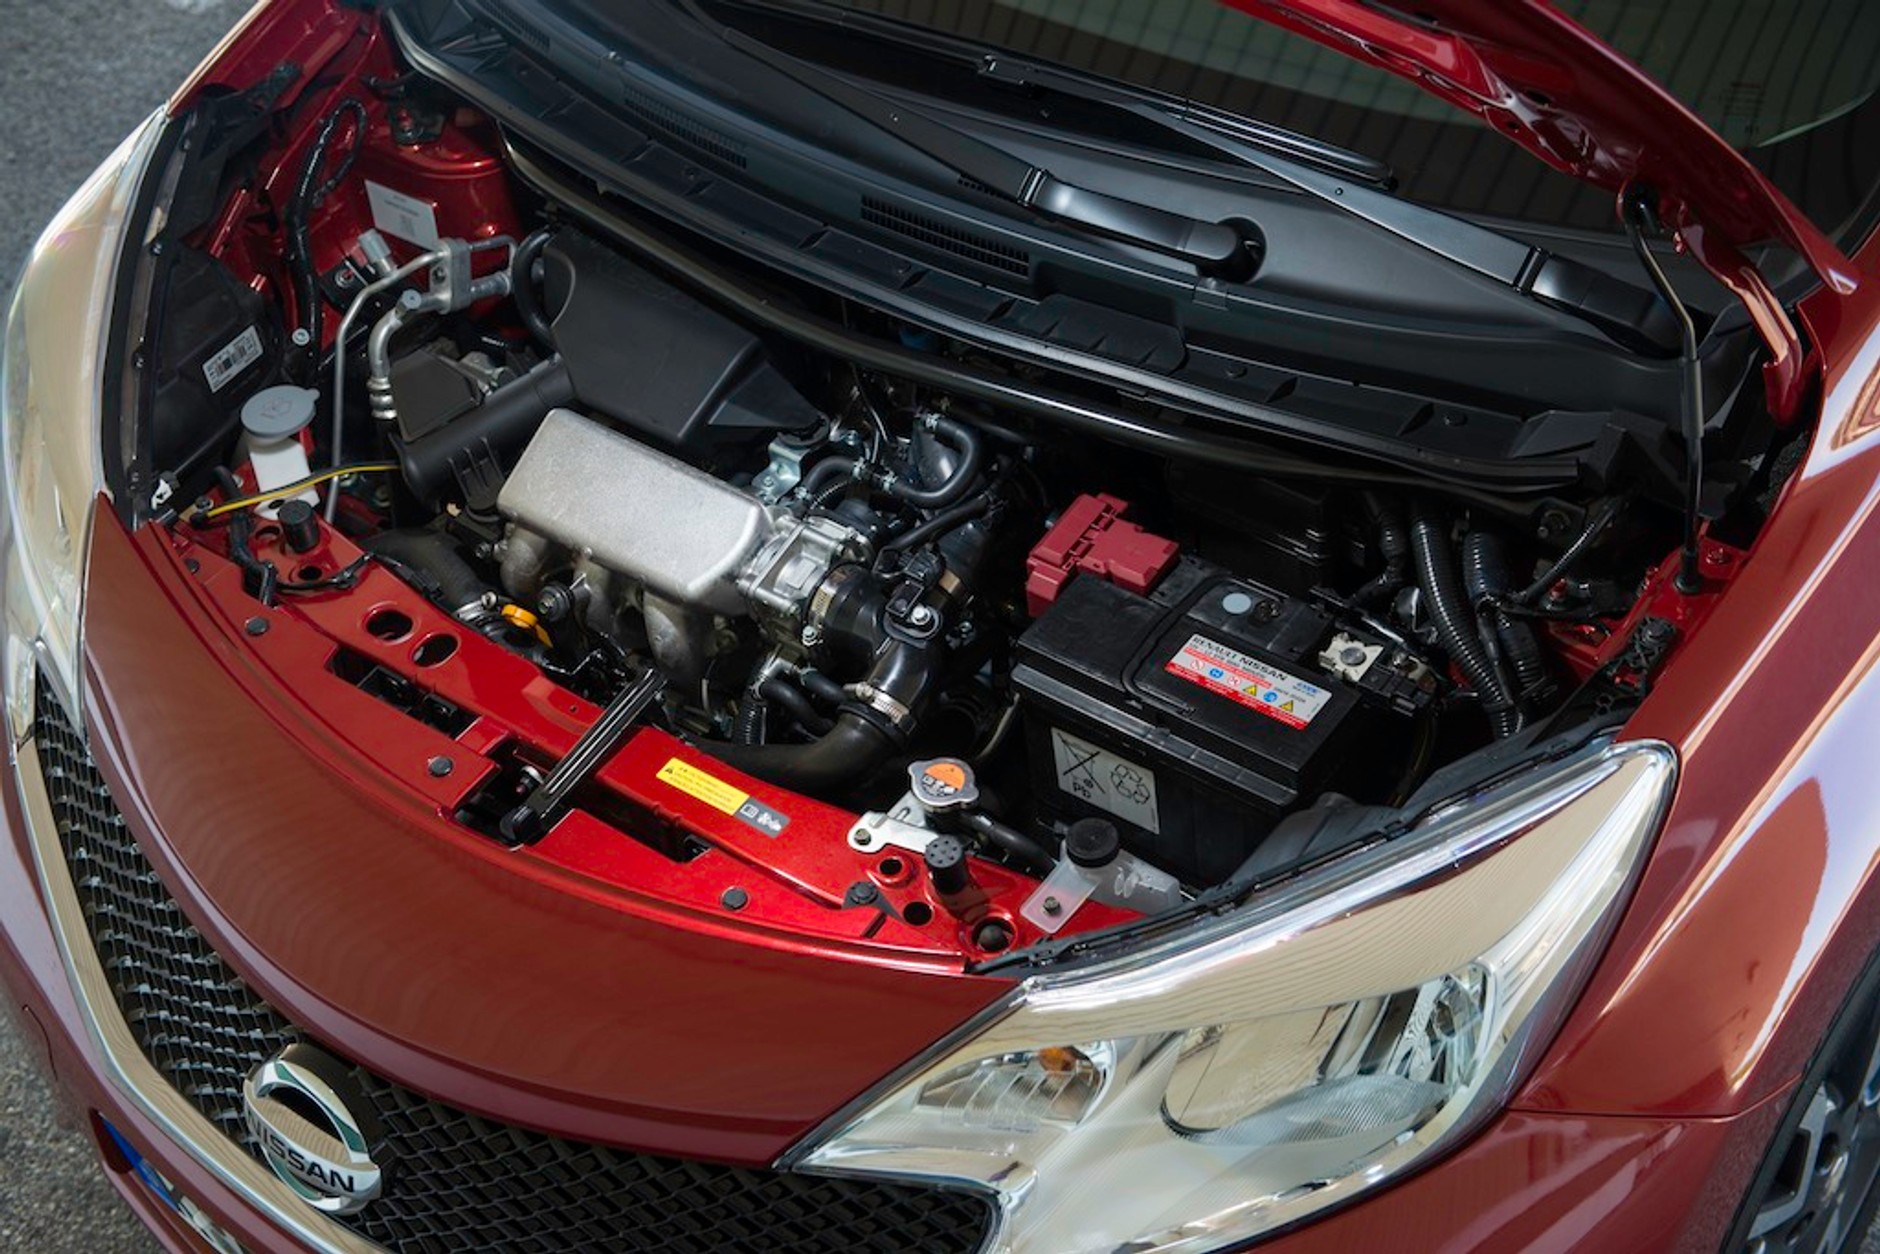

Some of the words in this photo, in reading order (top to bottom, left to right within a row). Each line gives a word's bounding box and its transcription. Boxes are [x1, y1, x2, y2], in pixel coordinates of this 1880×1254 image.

[1192, 637, 1238, 660] RENAULT
[1239, 656, 1288, 681] NISSAN
[1072, 781, 1091, 799] Pb
[247, 1107, 355, 1193] NISSAN
